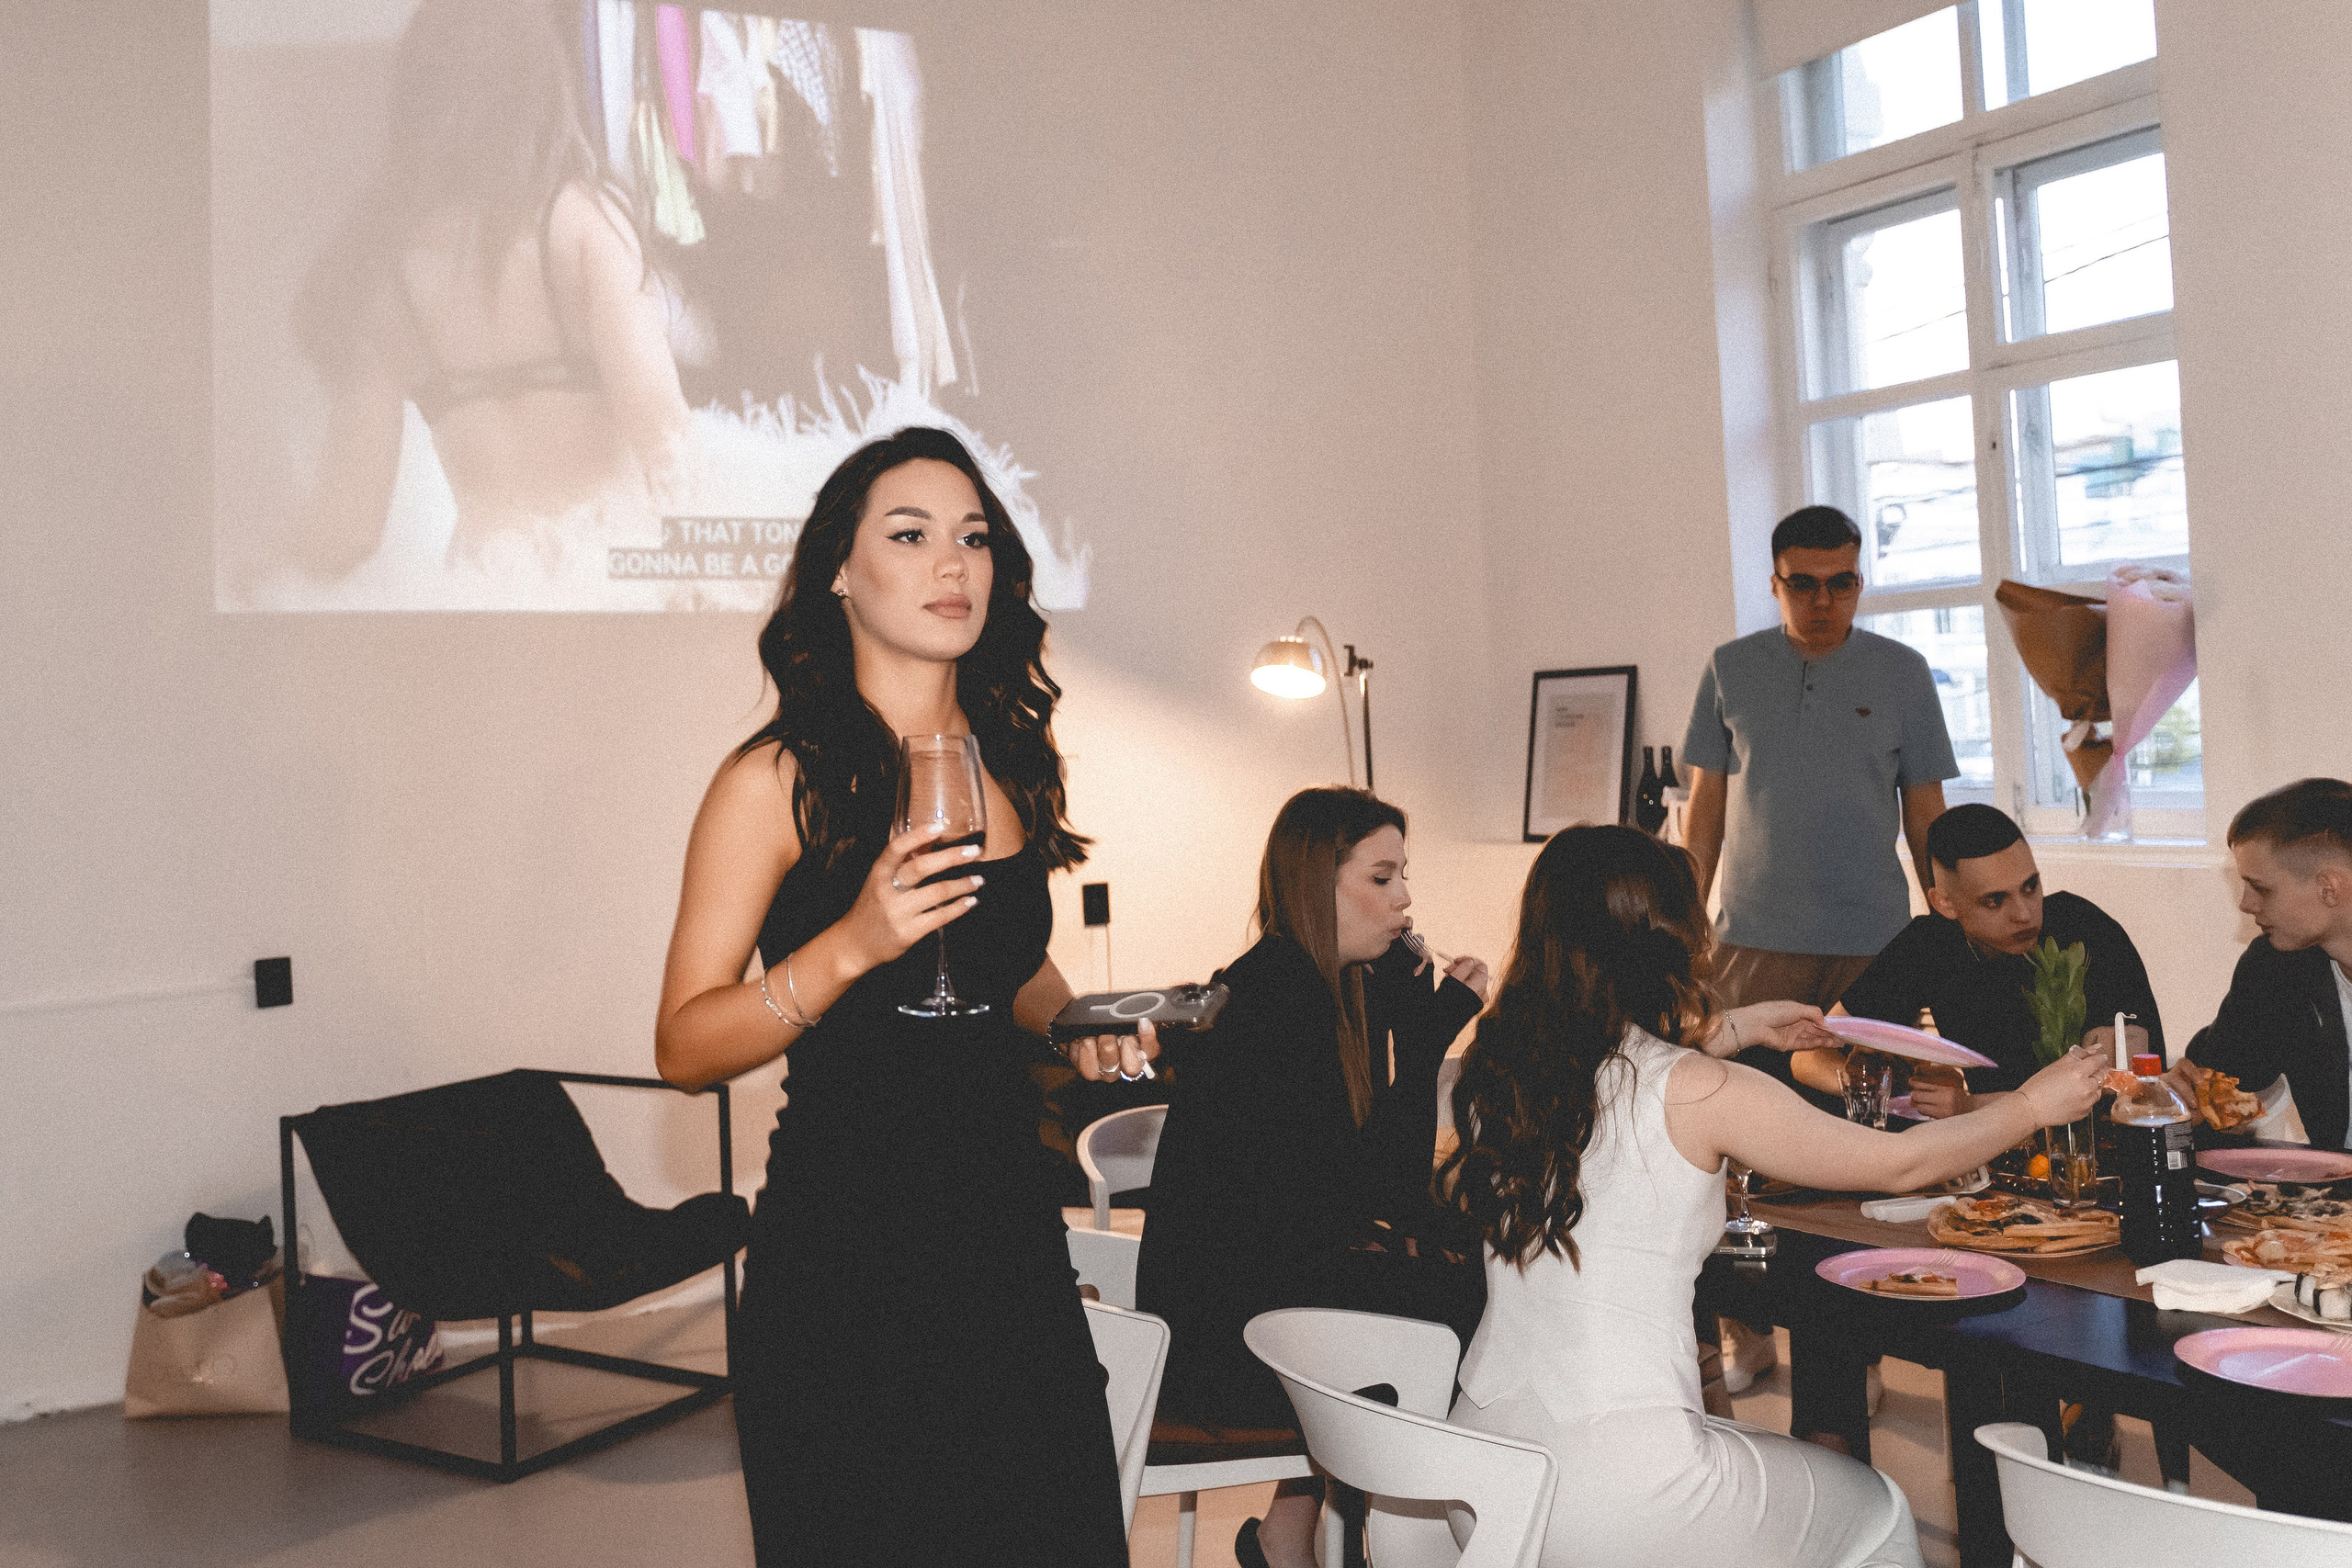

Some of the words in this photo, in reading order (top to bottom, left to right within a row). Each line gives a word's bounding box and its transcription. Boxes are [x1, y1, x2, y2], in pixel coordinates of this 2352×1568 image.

[679, 520, 742, 544] THAT
[609, 551, 699, 576] GONNA
[704, 552, 734, 576] BE
[740, 553, 760, 576] A
